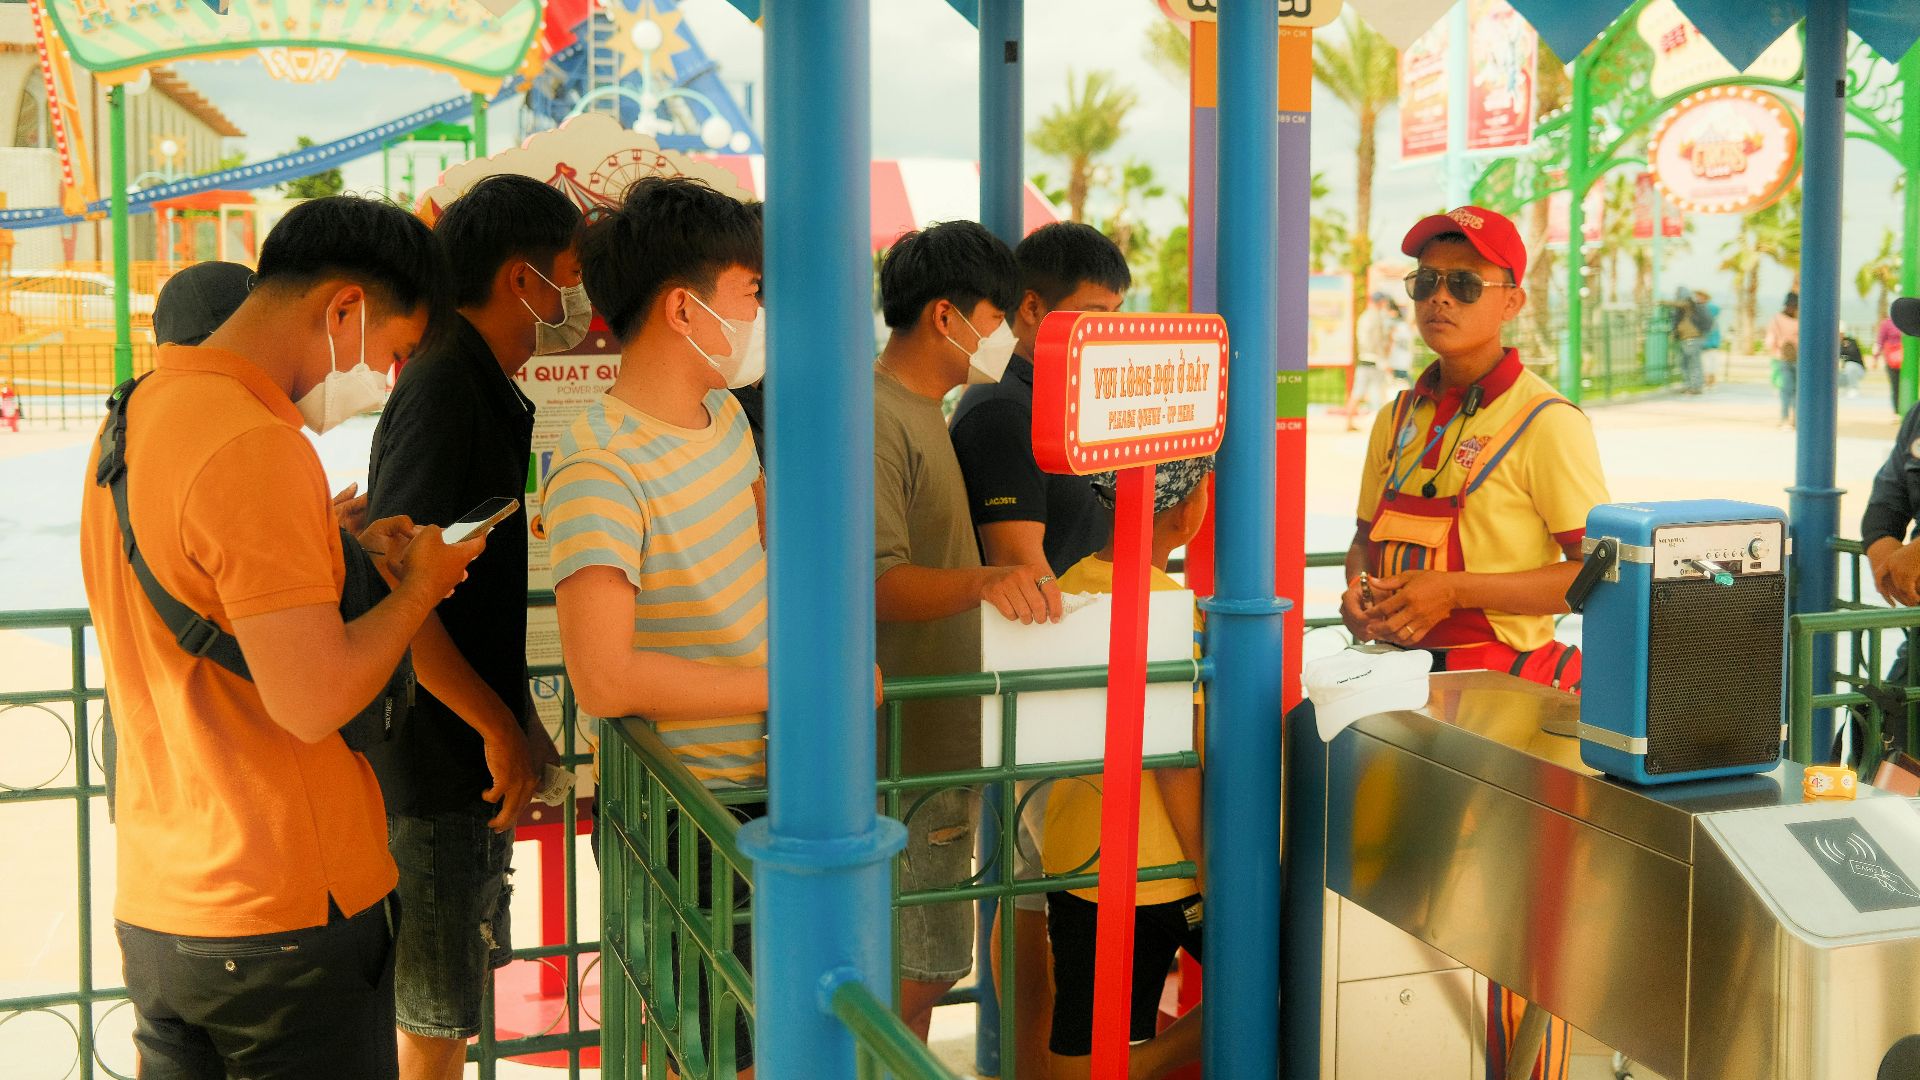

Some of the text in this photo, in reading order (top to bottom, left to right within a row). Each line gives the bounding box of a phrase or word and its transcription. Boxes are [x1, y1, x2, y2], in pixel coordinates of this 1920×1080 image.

[1292, 115, 1307, 124] CM
[1093, 367, 1118, 400] VUI
[1119, 357, 1152, 398] LÒNG
[557, 384, 609, 395] POWER SW
[1108, 409, 1136, 430] PLEASE
[1167, 405, 1177, 424] UP
[1177, 404, 1195, 423] HERE
[985, 496, 1017, 506] LACOSTE
